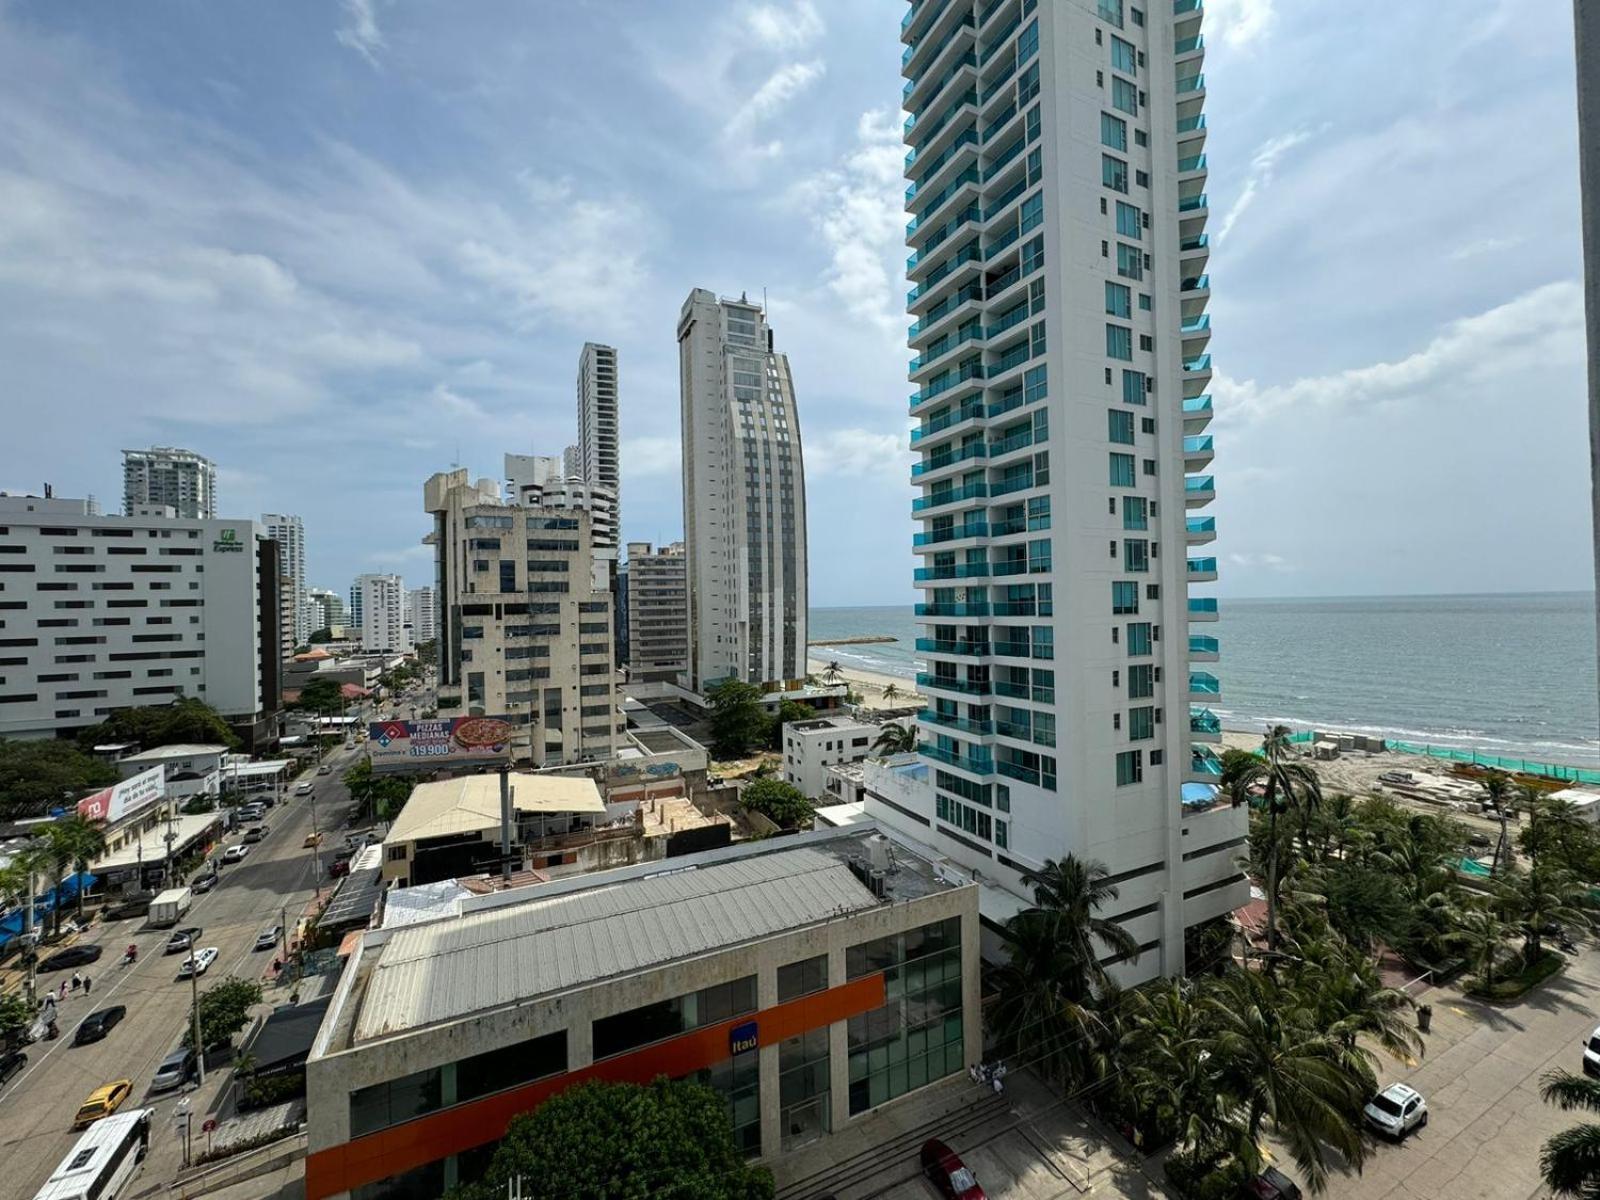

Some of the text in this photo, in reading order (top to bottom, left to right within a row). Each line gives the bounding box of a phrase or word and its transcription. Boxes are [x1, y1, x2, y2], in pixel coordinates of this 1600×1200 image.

[417, 724, 443, 732] PIZZAS
[410, 731, 449, 739] MEDIANAS
[732, 1034, 756, 1053] Itaú
